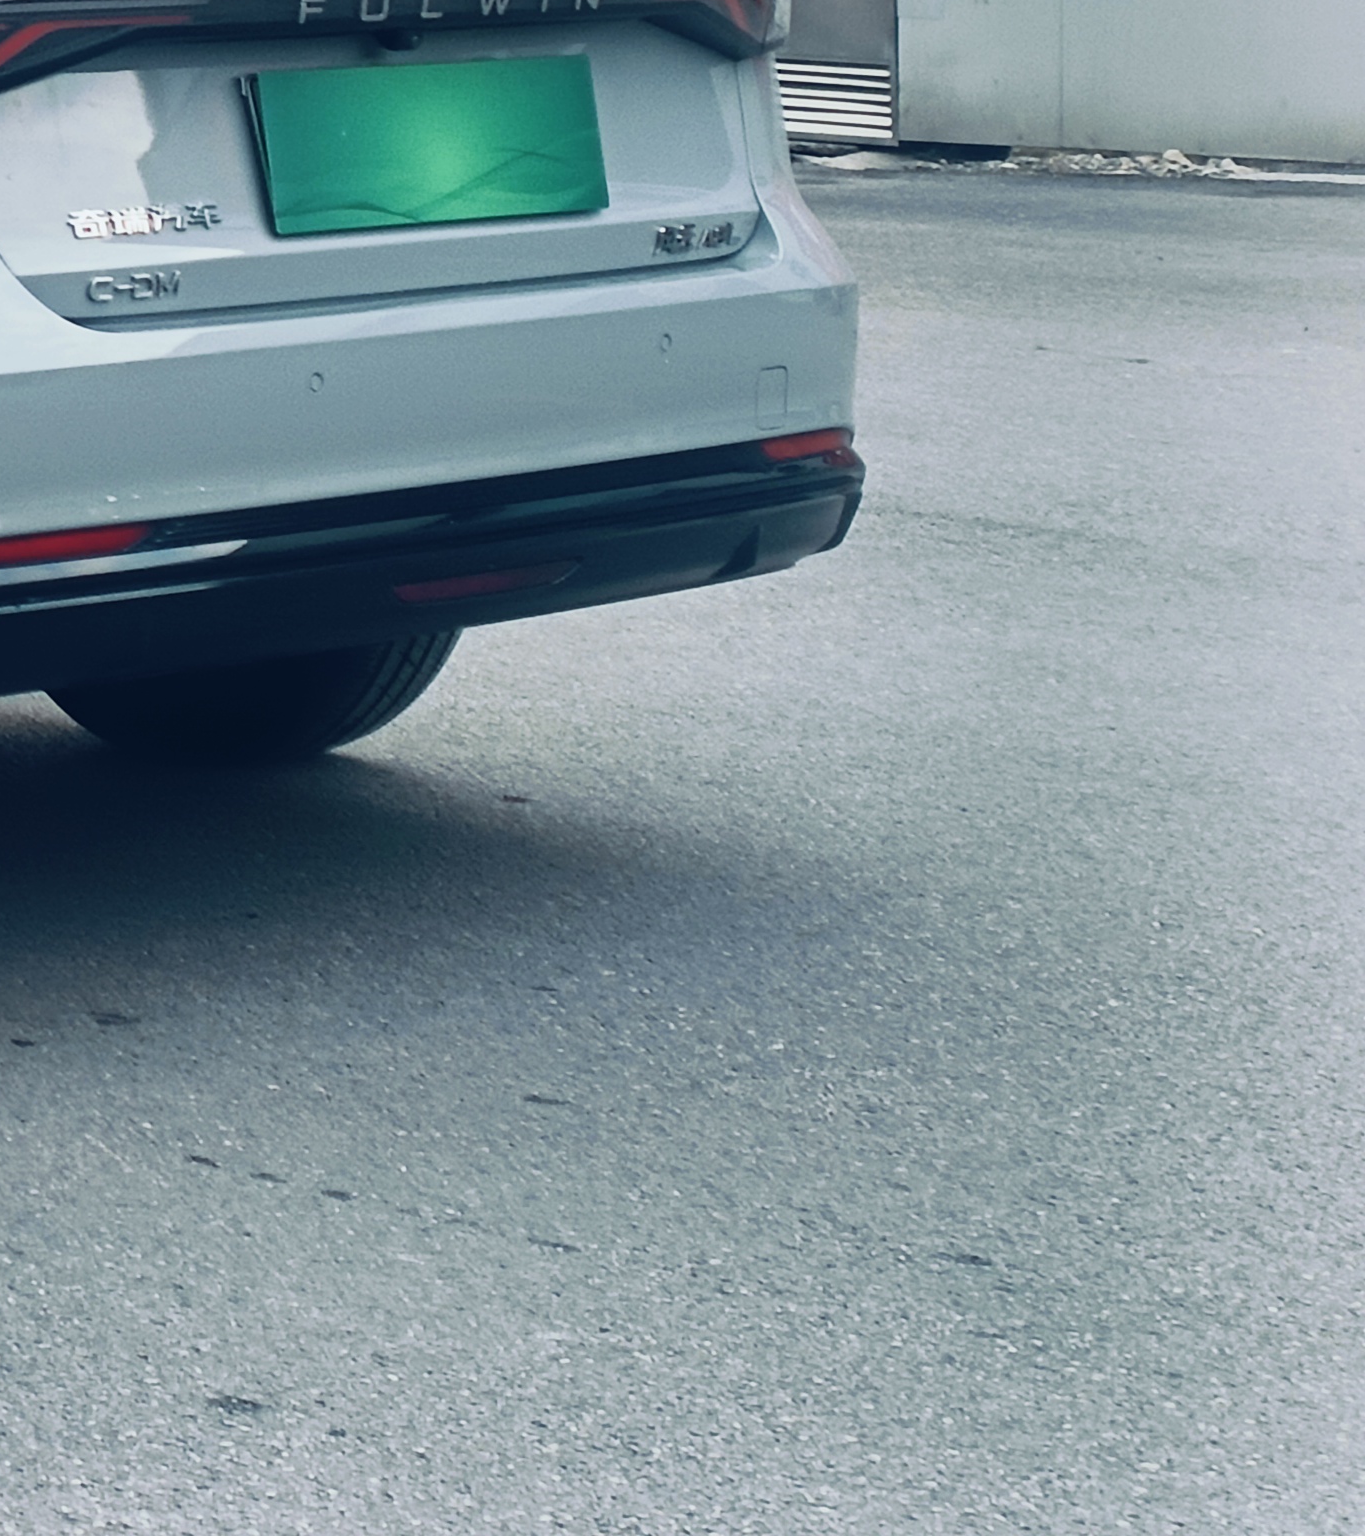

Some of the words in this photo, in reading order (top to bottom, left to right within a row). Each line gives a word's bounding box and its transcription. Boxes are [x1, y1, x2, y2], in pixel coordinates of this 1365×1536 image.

[67, 204, 221, 239] 奇瑞汽车
[86, 270, 181, 302] C-DM
